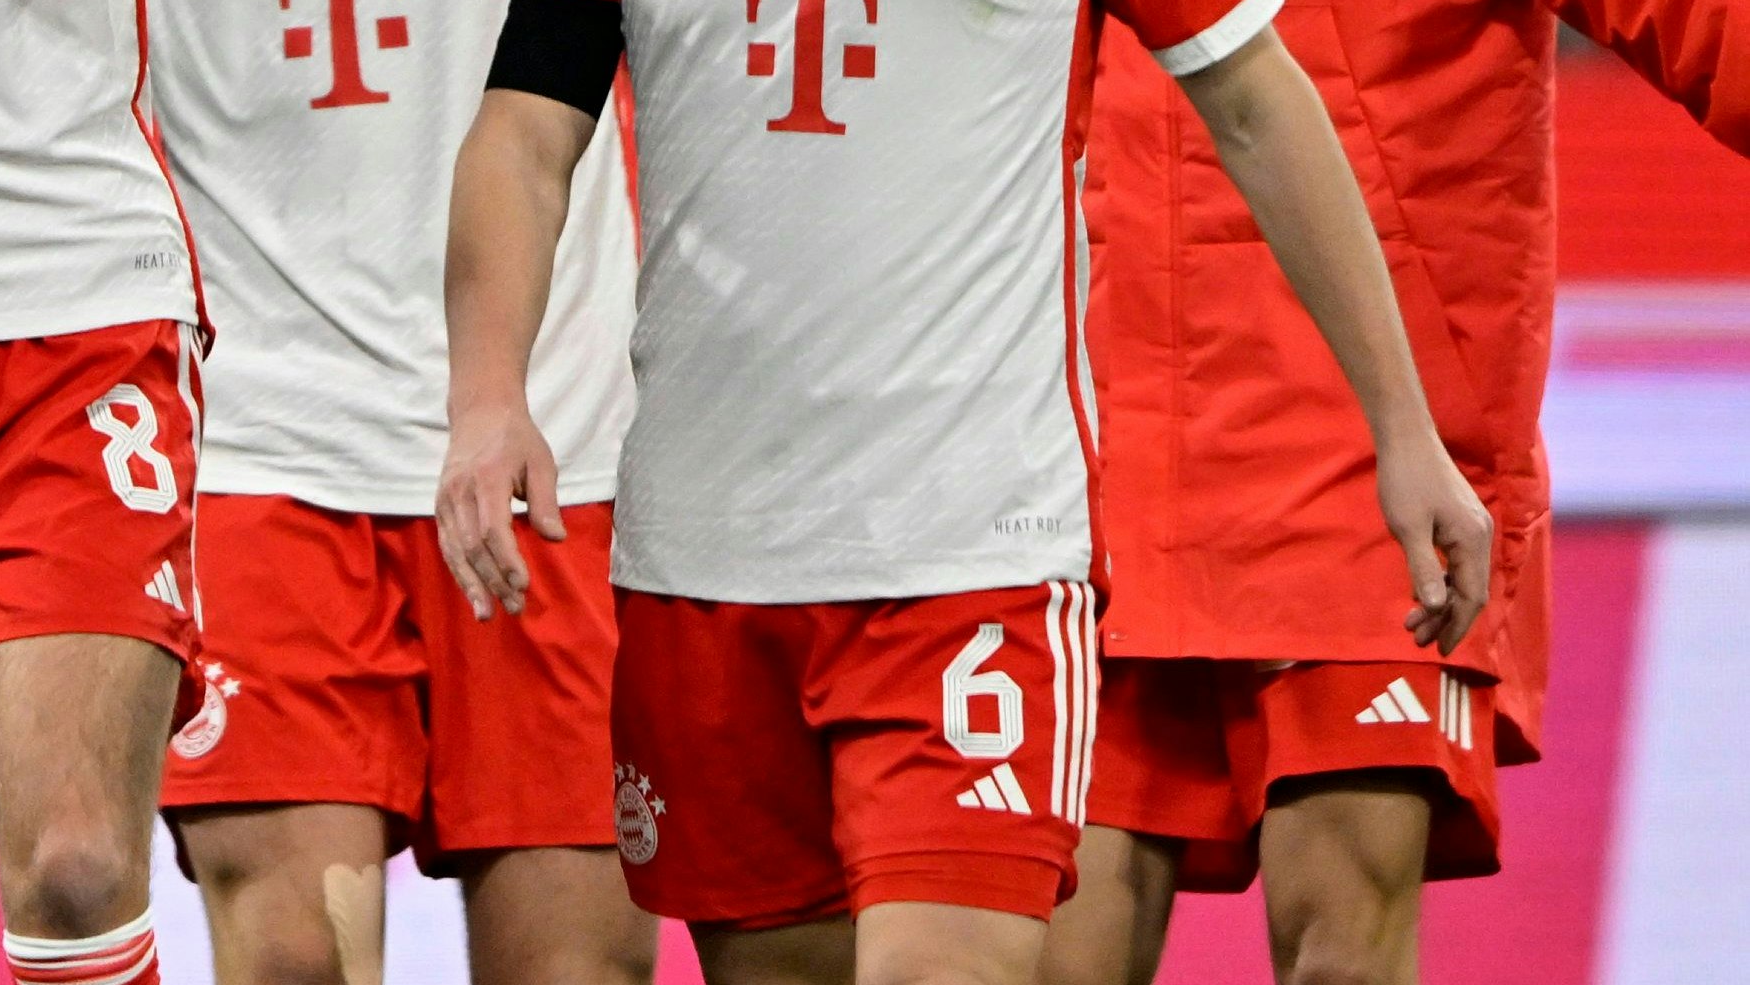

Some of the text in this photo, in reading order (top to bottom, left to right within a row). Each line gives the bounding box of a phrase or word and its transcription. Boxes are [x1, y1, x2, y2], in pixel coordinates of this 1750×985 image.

[135, 252, 165, 269] HEAT
[86, 383, 178, 515] 8
[994, 515, 1061, 534] HEAT RDY
[942, 623, 1024, 759] 6
